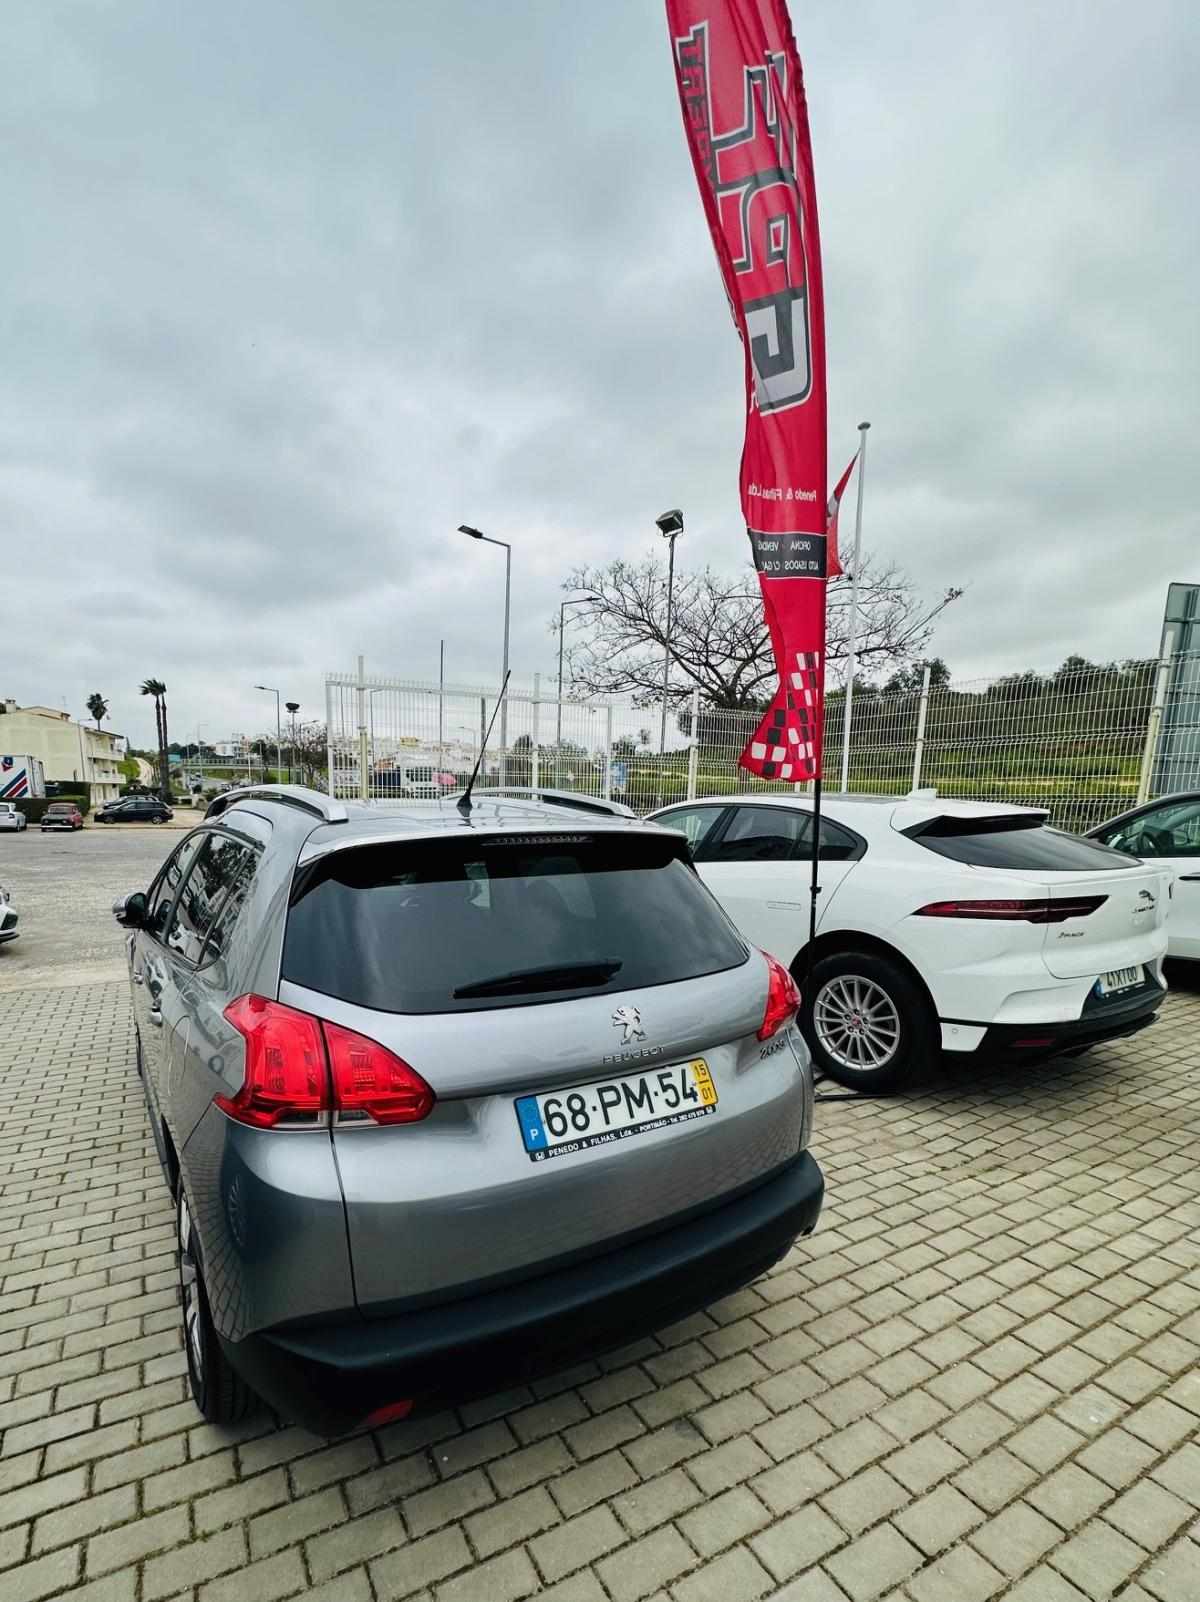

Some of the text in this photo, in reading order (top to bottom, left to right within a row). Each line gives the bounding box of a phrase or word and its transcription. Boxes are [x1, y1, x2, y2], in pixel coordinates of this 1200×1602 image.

[694, 1063, 707, 1078] 15
[701, 1087, 714, 1100] 01
[530, 1128, 539, 1141] P
